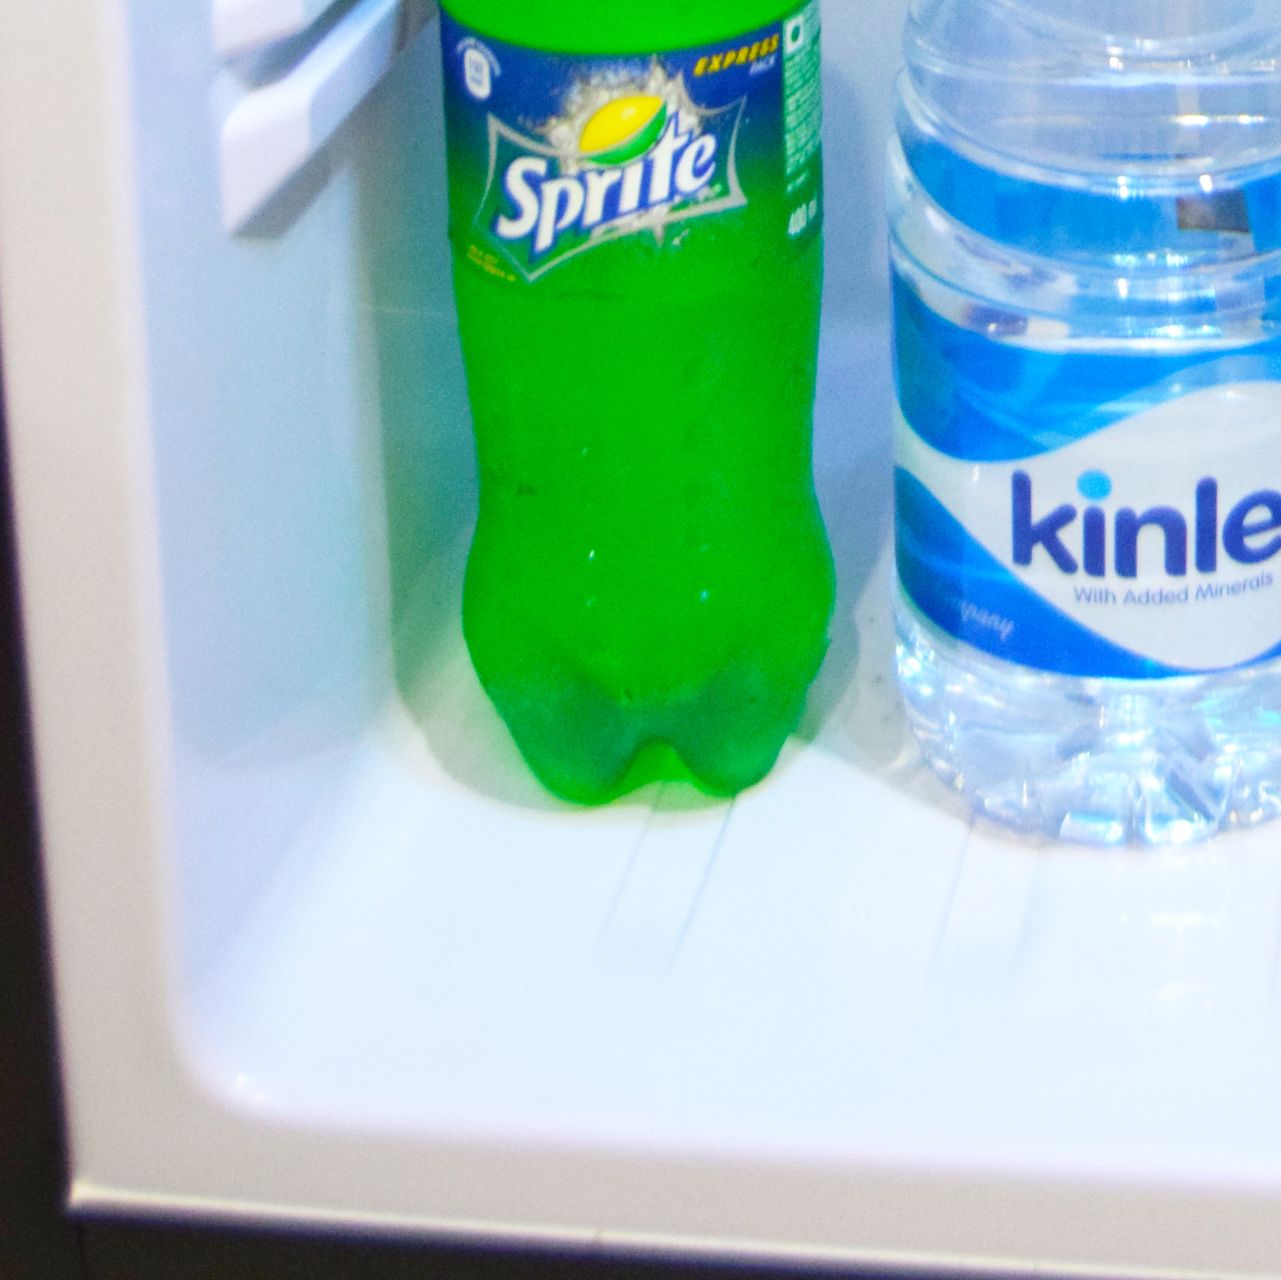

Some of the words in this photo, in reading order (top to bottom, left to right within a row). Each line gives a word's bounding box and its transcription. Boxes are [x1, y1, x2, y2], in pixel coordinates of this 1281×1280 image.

[693, 33, 780, 78] EXPRESS
[496, 114, 718, 253] Sprite
[1073, 585, 1117, 606] With
[1122, 586, 1189, 606] Added
[1195, 572, 1274, 601] Minerals
